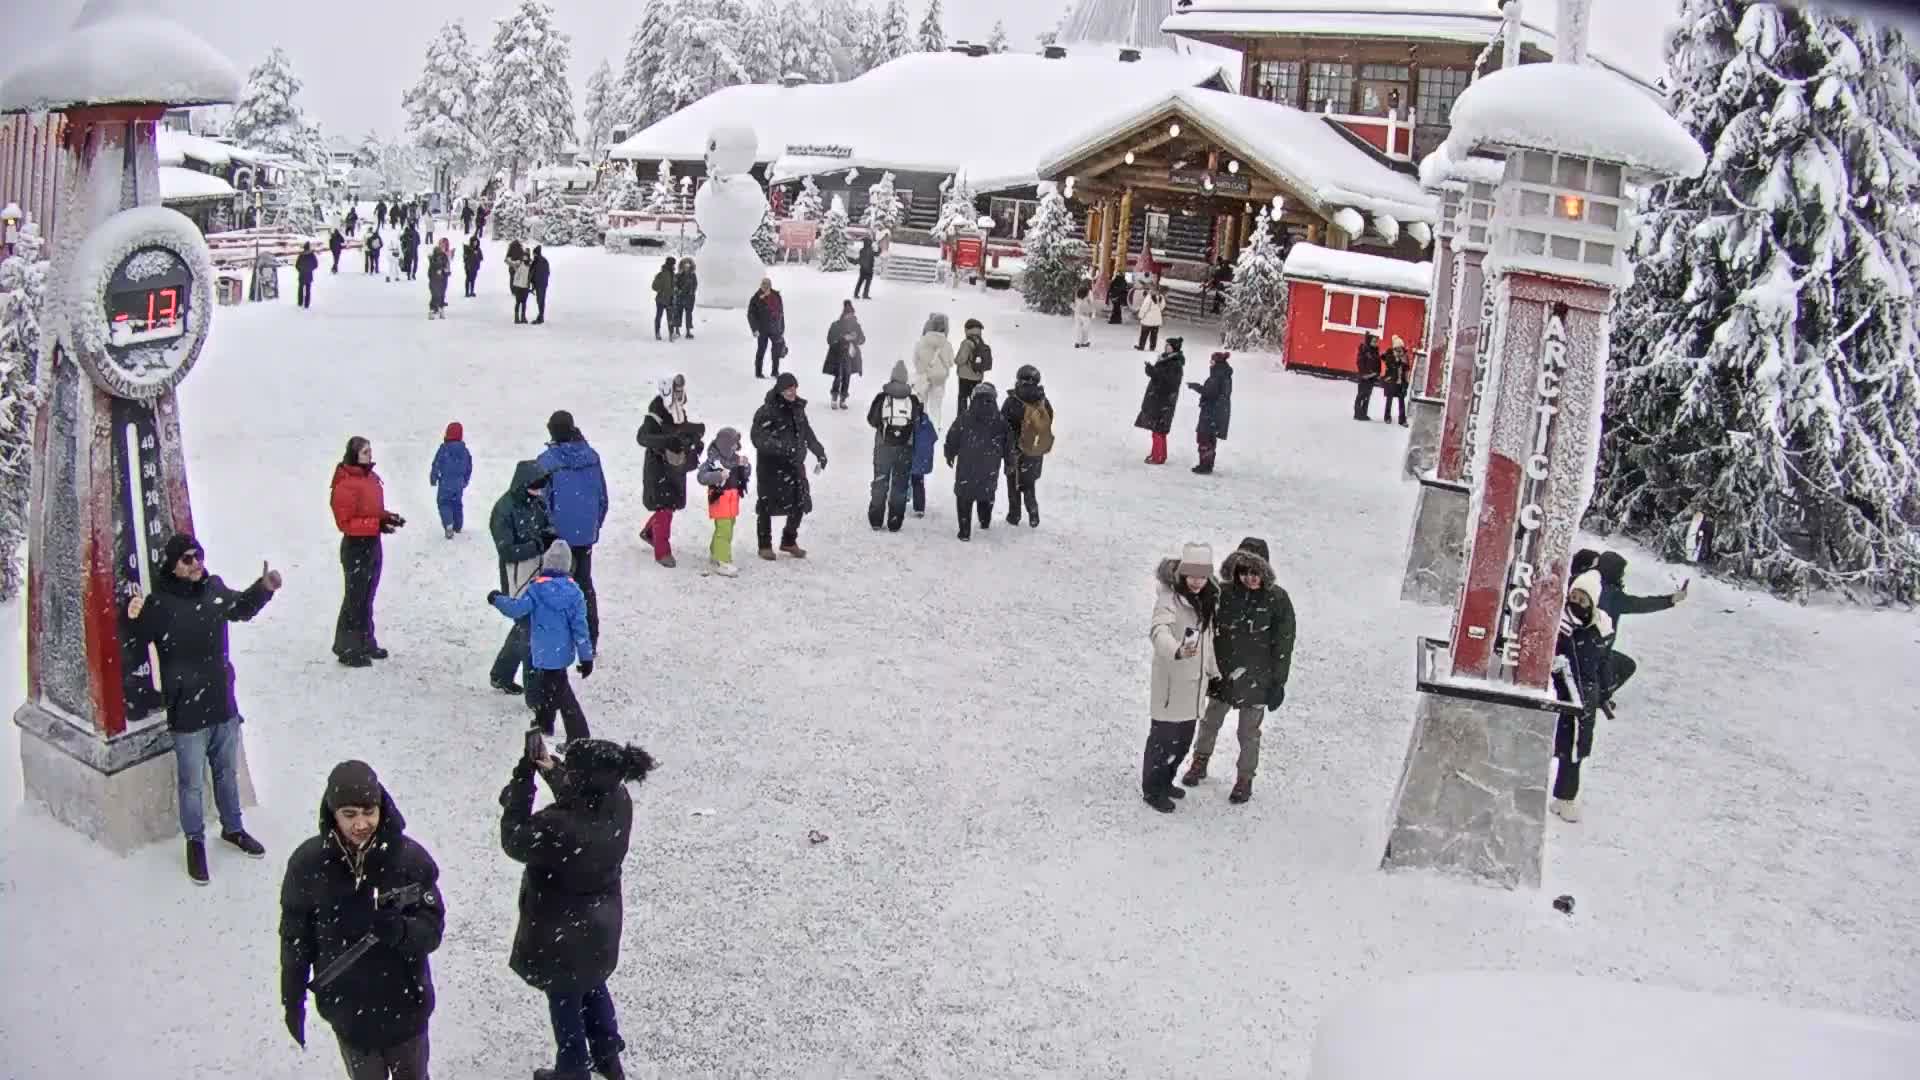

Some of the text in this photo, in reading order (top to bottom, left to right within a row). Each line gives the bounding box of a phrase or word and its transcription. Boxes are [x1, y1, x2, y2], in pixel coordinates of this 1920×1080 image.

[129, 383, 166, 399] CLAUS
[141, 434, 155, 450] 40
[143, 462, 157, 478] 30
[146, 490, 160, 506] 20
[1501, 315, 1569, 667] ARCTIC CIRCLE
[149, 520, 161, 536] 10
[129, 553, 136, 569] 0
[152, 548, 159, 562] 0
